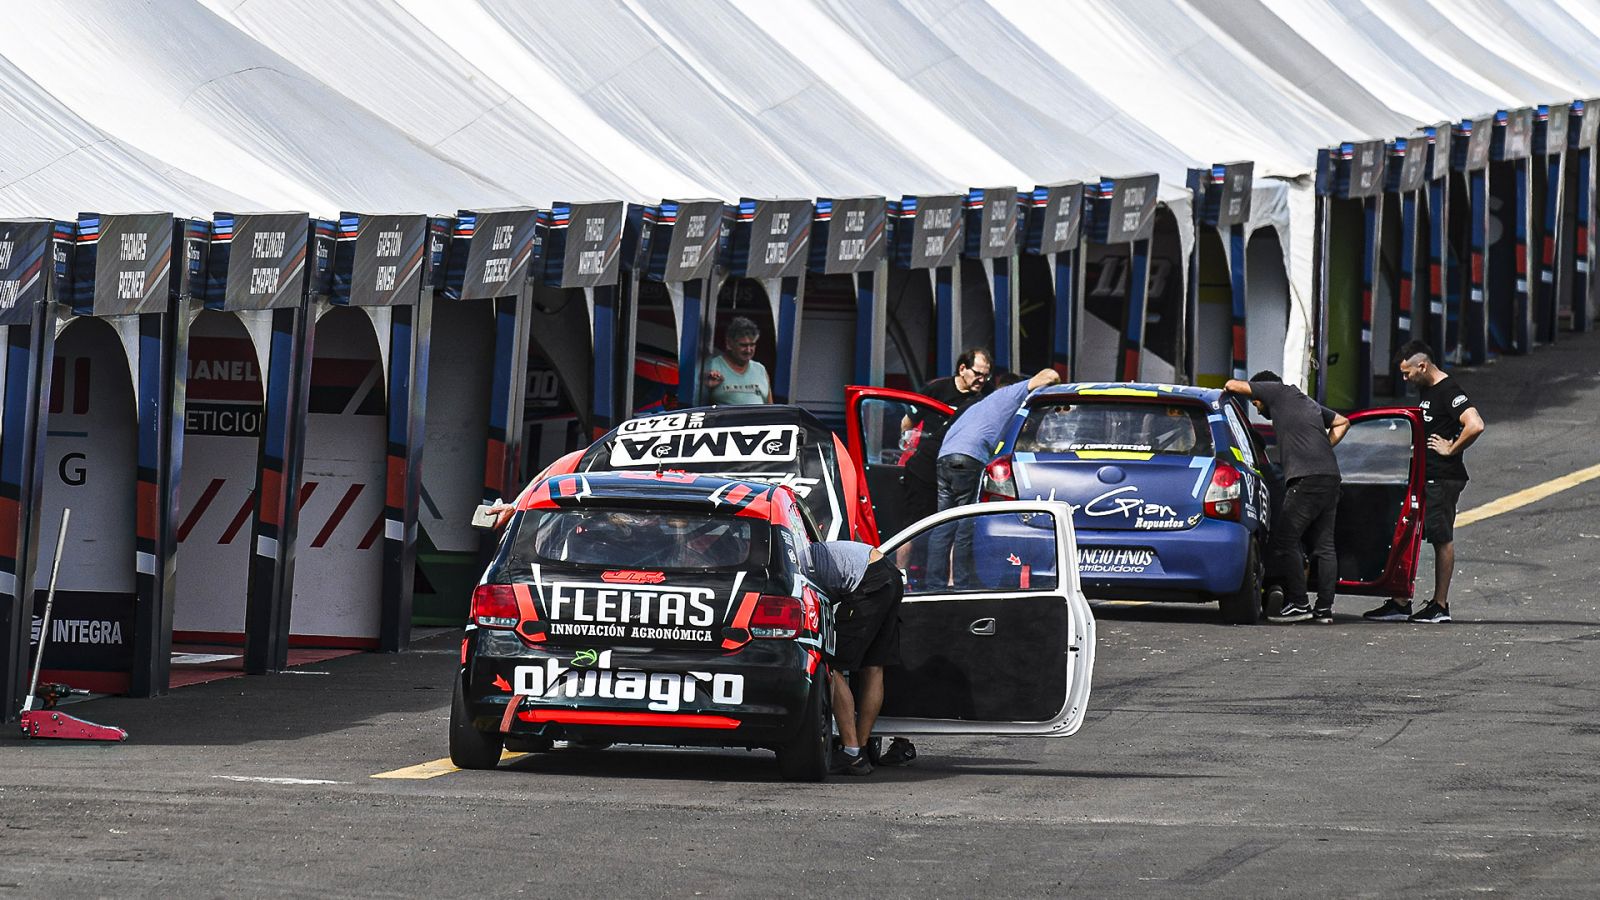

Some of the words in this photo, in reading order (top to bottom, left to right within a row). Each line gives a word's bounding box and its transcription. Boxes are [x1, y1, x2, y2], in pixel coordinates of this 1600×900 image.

[120, 232, 147, 261] THOMAS
[251, 231, 286, 258] FACUNDO
[376, 223, 403, 257] GASTÓN
[492, 225, 514, 250] LUCAS
[117, 270, 145, 299] POZNER
[249, 267, 280, 294] CHAPUR
[620, 429, 793, 461] PAMPA
[58, 453, 87, 486] G
[1134, 517, 1185, 530] Repuestos
[1114, 550, 1154, 566] HNOS
[550, 582, 715, 627] FLEITAS
[52, 619, 122, 645] INTEGRA
[550, 625, 625, 638] INNOVACIÓN
[631, 625, 713, 643] AGRONÓMICA
